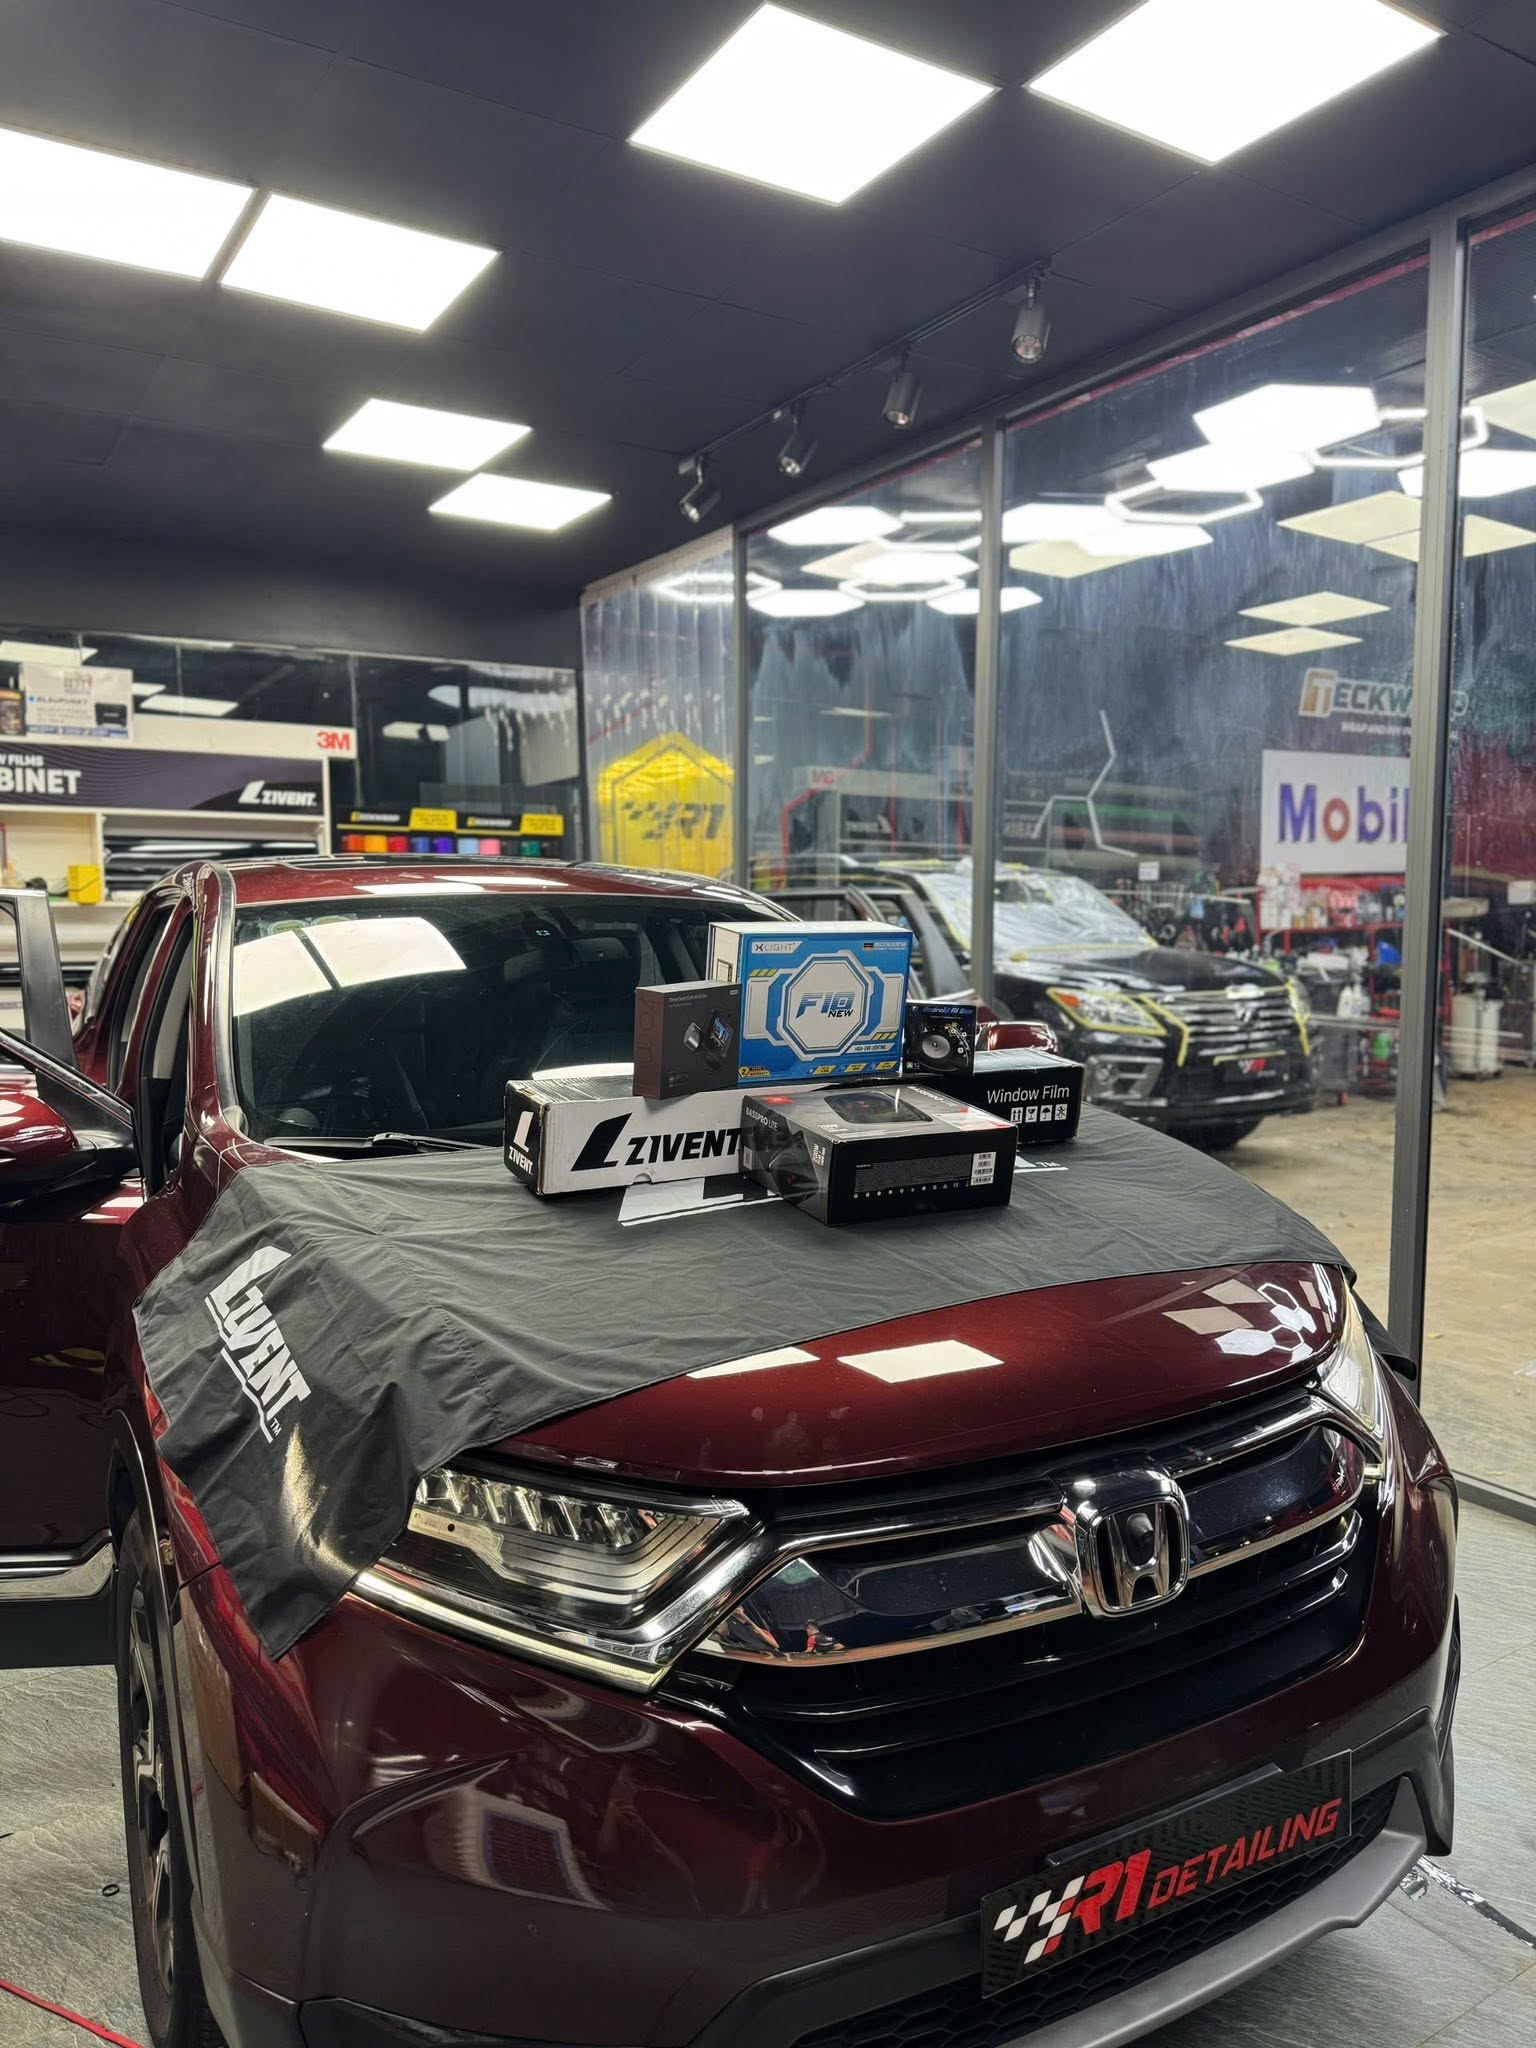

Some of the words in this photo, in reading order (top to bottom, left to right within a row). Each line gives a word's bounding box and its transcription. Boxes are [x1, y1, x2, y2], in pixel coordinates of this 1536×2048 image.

[317, 731, 351, 750] 3M
[8, 753, 44, 767] FILMS
[261, 790, 316, 806] ZIVENT
[828, 1009, 854, 1018] NEW
[987, 1087, 1040, 1104] Window
[1042, 1084, 1070, 1100] Film
[745, 1106, 769, 1126] BASSPRO
[768, 1119, 778, 1131] LITE
[624, 1127, 743, 1166] ZIVENT
[508, 1145, 534, 1175] ZIVENT
[269, 1417, 283, 1437] TM
[1147, 1797, 1343, 1910] DETAILING
